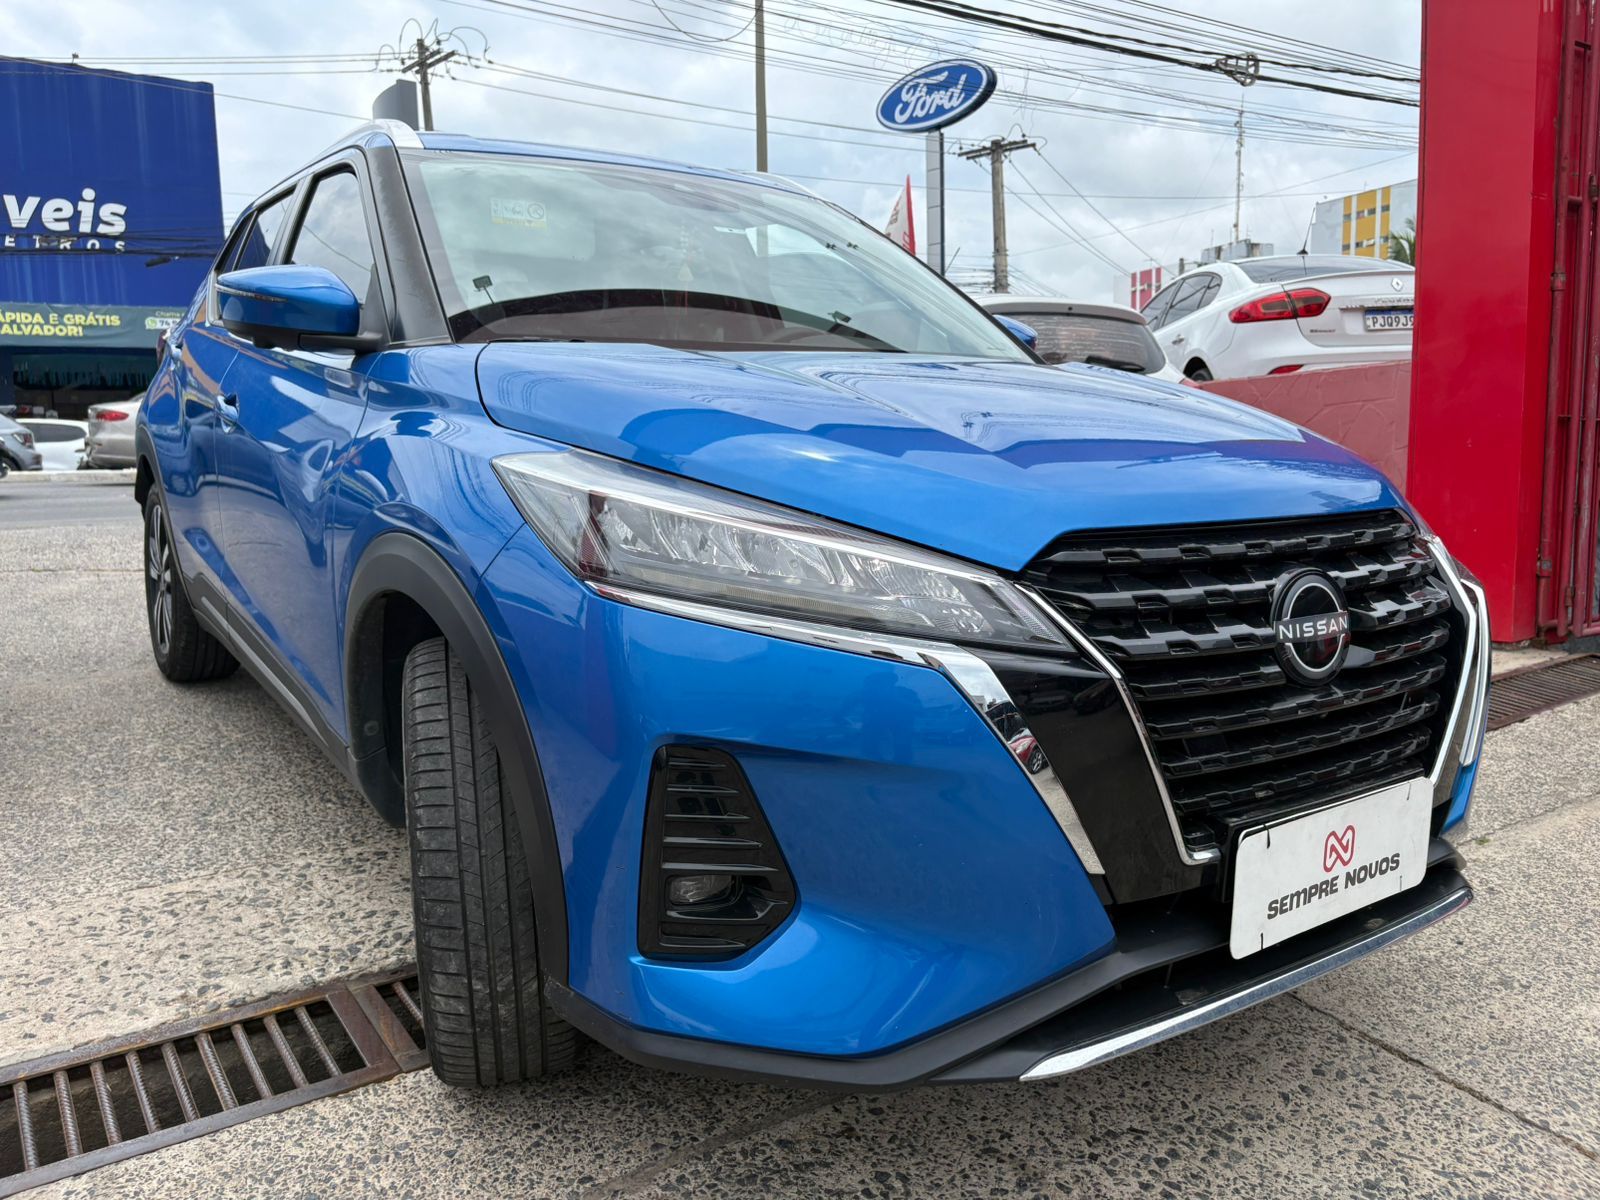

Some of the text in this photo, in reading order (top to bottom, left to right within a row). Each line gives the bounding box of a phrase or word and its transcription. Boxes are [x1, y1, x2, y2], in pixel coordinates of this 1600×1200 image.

[894, 71, 967, 123] Ford
[3, 188, 127, 235] veis
[49, 313, 59, 324] E
[63, 312, 121, 326] GRÁTIS
[1279, 616, 1348, 639] NISSAN
[1267, 875, 1340, 920] SEMPRE
